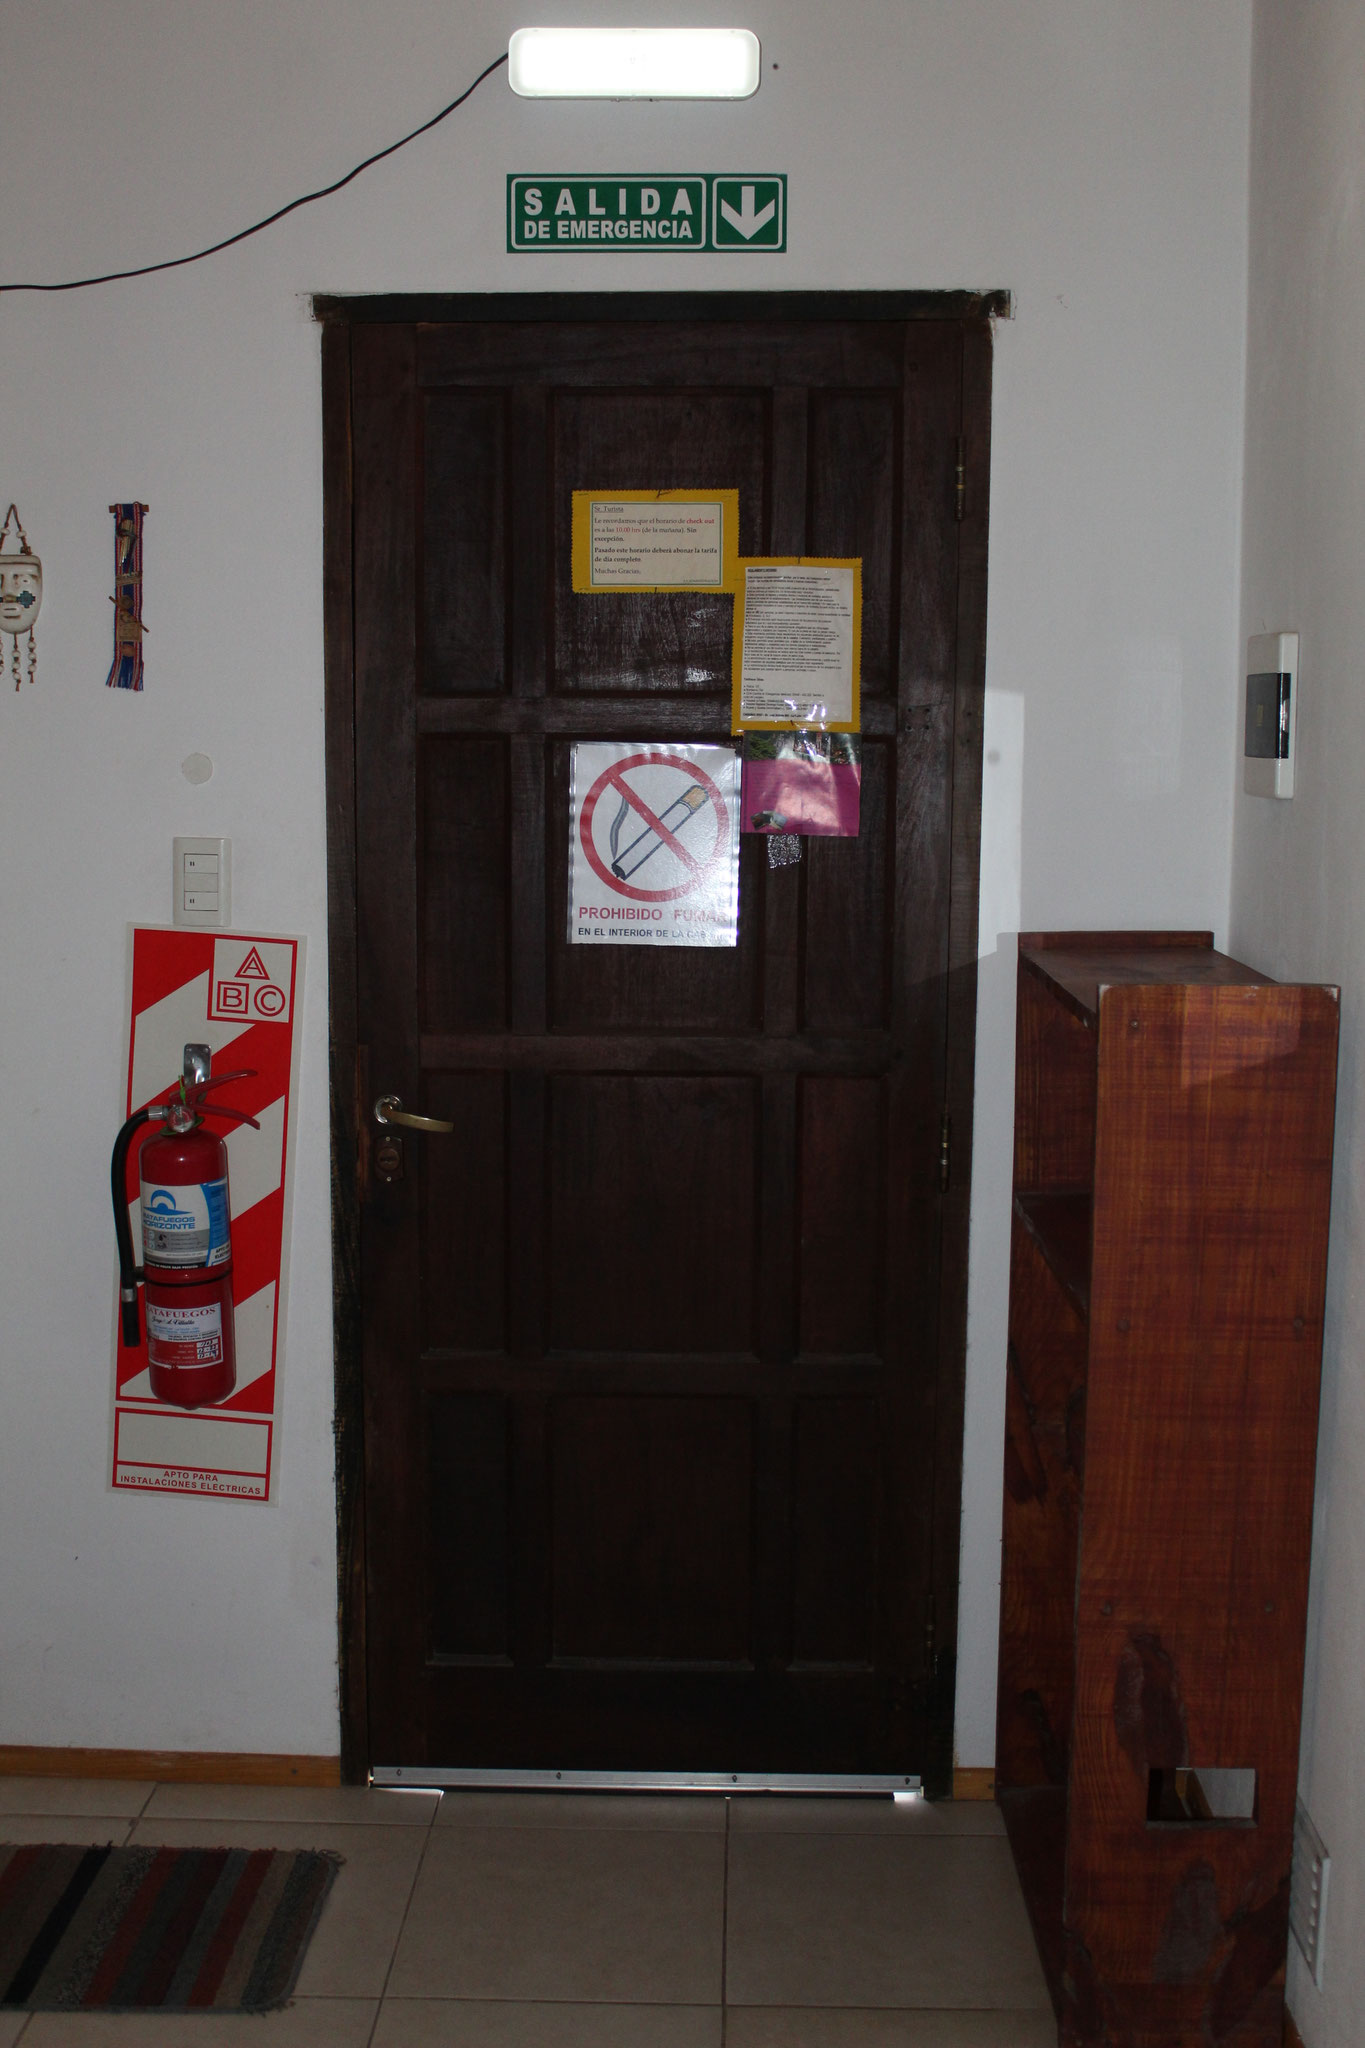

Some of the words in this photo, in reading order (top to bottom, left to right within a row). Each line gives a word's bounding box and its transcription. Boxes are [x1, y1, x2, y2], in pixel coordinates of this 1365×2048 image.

[523, 188, 693, 215] SALIDA
[523, 220, 551, 239] DE
[557, 220, 693, 239] EMERGENCIA
[604, 505, 624, 513] Turista
[579, 907, 663, 920] PROHIBIDO
[673, 908, 728, 922] FUMAR
[578, 928, 591, 936] EN
[594, 928, 605, 936] EL
[609, 928, 653, 938] INTERIOR
[656, 929, 668, 938] DE
[672, 930, 684, 938] LA
[242, 955, 263, 975] A
[222, 986, 243, 1007] B
[260, 991, 277, 1011] C
[120, 1475, 197, 1488] INSTALACIONES
[200, 1482, 261, 1494] ELECTRICAS
[164, 1470, 189, 1479] APTO
[193, 1473, 218, 1482] PARA
